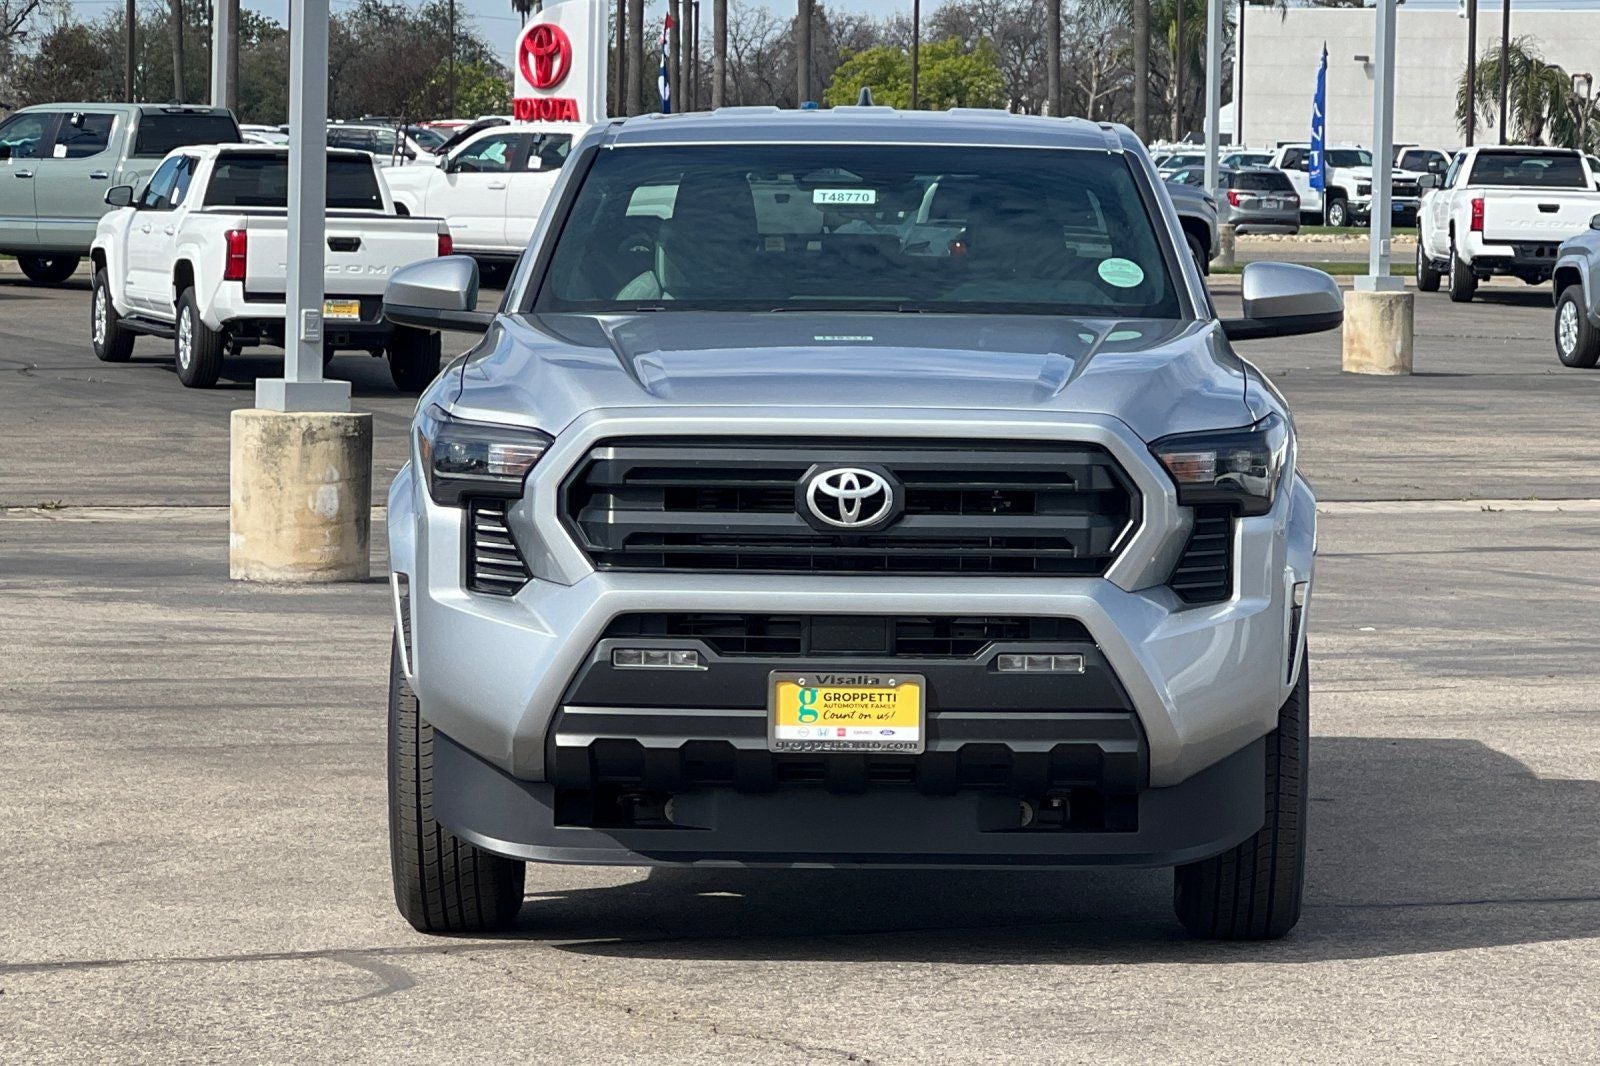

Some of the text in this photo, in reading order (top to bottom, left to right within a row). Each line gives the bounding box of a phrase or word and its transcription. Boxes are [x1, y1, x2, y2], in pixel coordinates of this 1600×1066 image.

[512, 97, 580, 123] TOYOTA
[820, 193, 870, 202] T48770
[815, 675, 881, 686] Visalia
[823, 692, 897, 703] GROPPETTI
[823, 710, 855, 721] Count
[877, 711, 896, 721] us!
